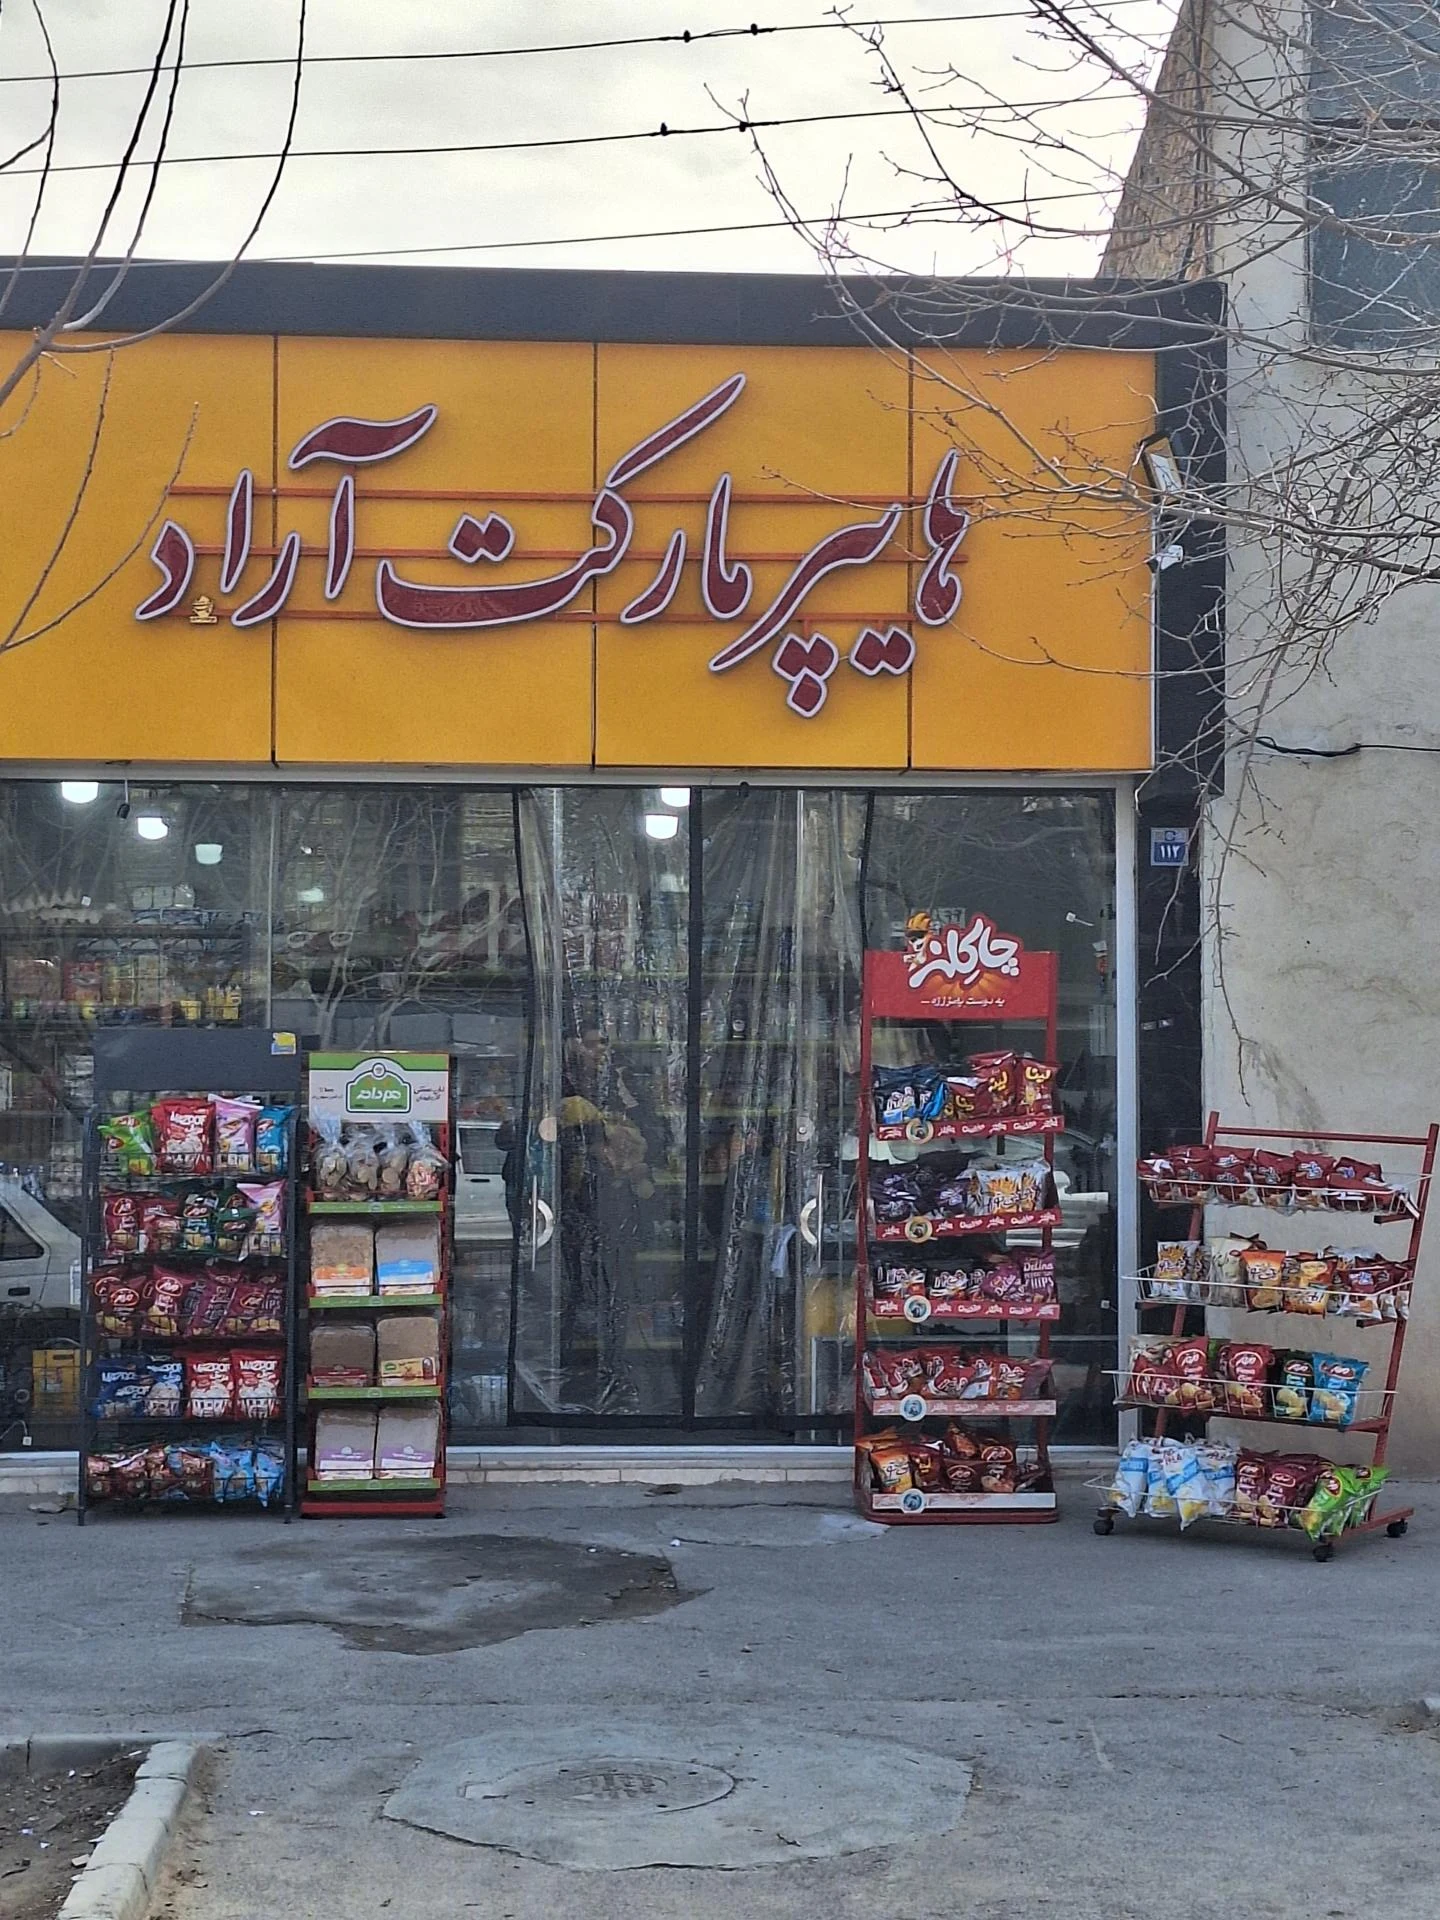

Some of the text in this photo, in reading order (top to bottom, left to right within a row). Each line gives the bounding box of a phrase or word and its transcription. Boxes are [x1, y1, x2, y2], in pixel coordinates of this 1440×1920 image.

[134, 370, 975, 720] هایپر مارکت آراد
